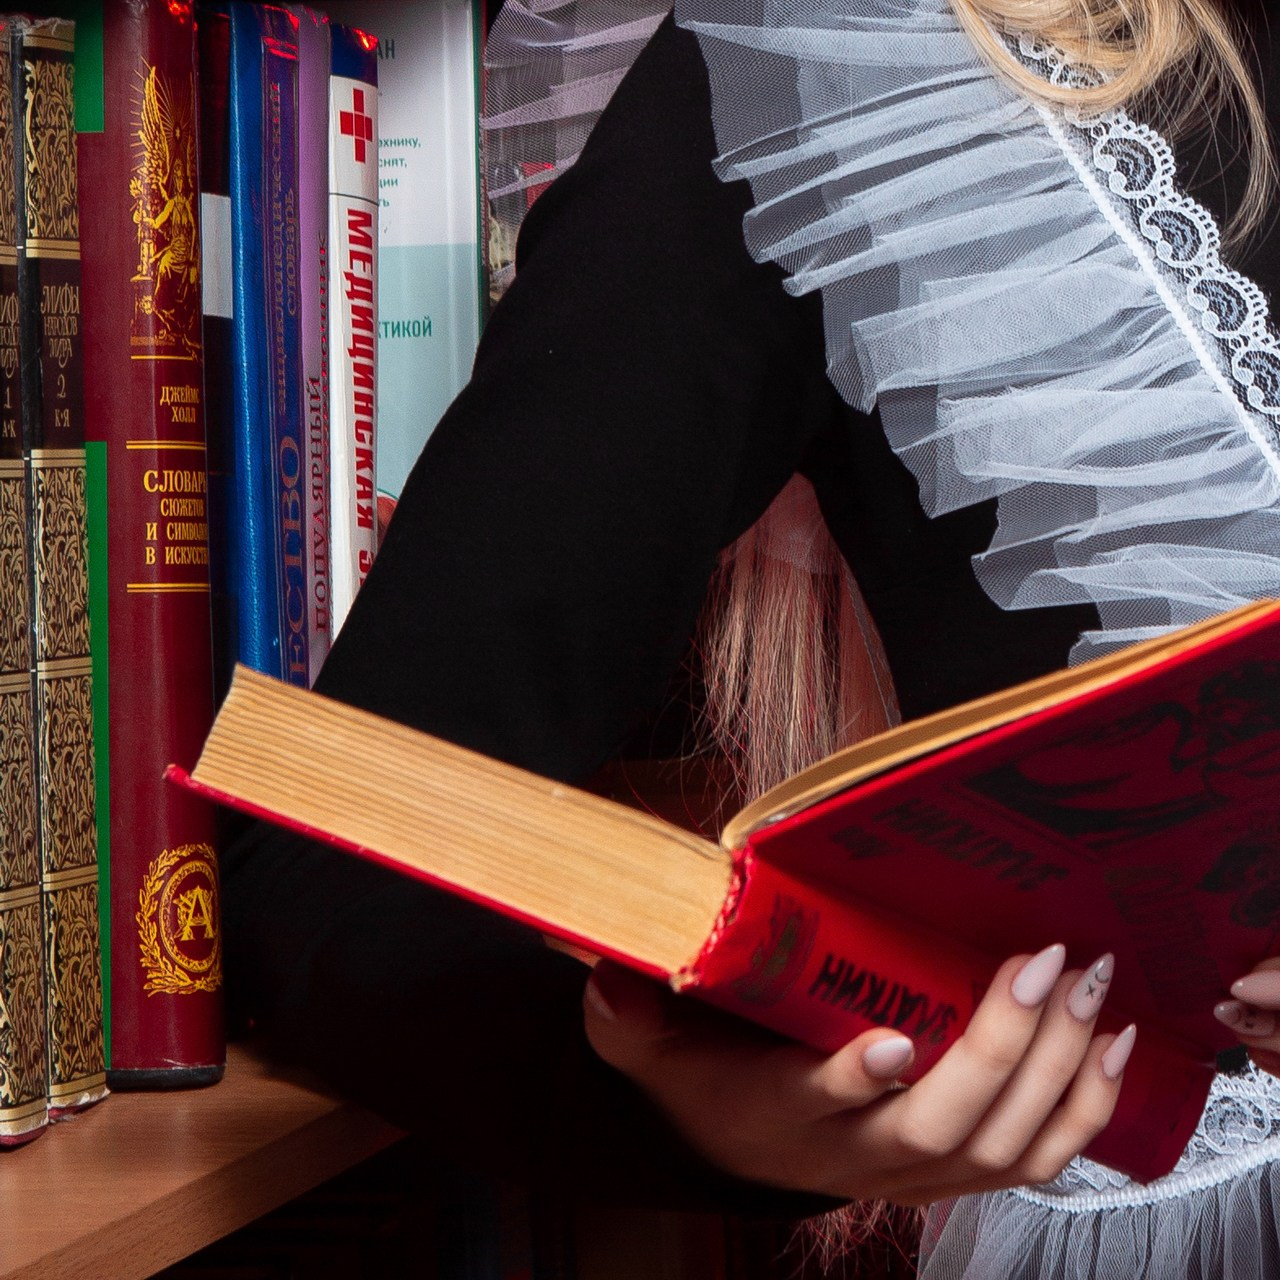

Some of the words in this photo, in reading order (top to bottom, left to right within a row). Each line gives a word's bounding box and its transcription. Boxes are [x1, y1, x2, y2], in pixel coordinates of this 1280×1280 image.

[284, 188, 297, 317] словарь
[40, 282, 80, 317] МИФЫ
[44, 316, 78, 336] НАРОДОВ
[49, 338, 73, 369] МИРА
[343, 207, 378, 530] МЕДИЦИНСКАЯ
[4, 386, 12, 409] 1
[57, 374, 67, 399] 2
[160, 385, 200, 406] ДЖЕЙМС
[171, 406, 196, 423] ХОЛЛ
[143, 469, 207, 494] СЛОВАРЬ
[160, 497, 204, 518] СЮЖЕТОВ
[305, 374, 327, 632] ПОПУЛЯРНЫЙ
[145, 522, 158, 541] И
[145, 546, 156, 565] В
[279, 435, 306, 674] ЕСТВО
[808, 952, 958, 1045] ЗЛАТКИН
